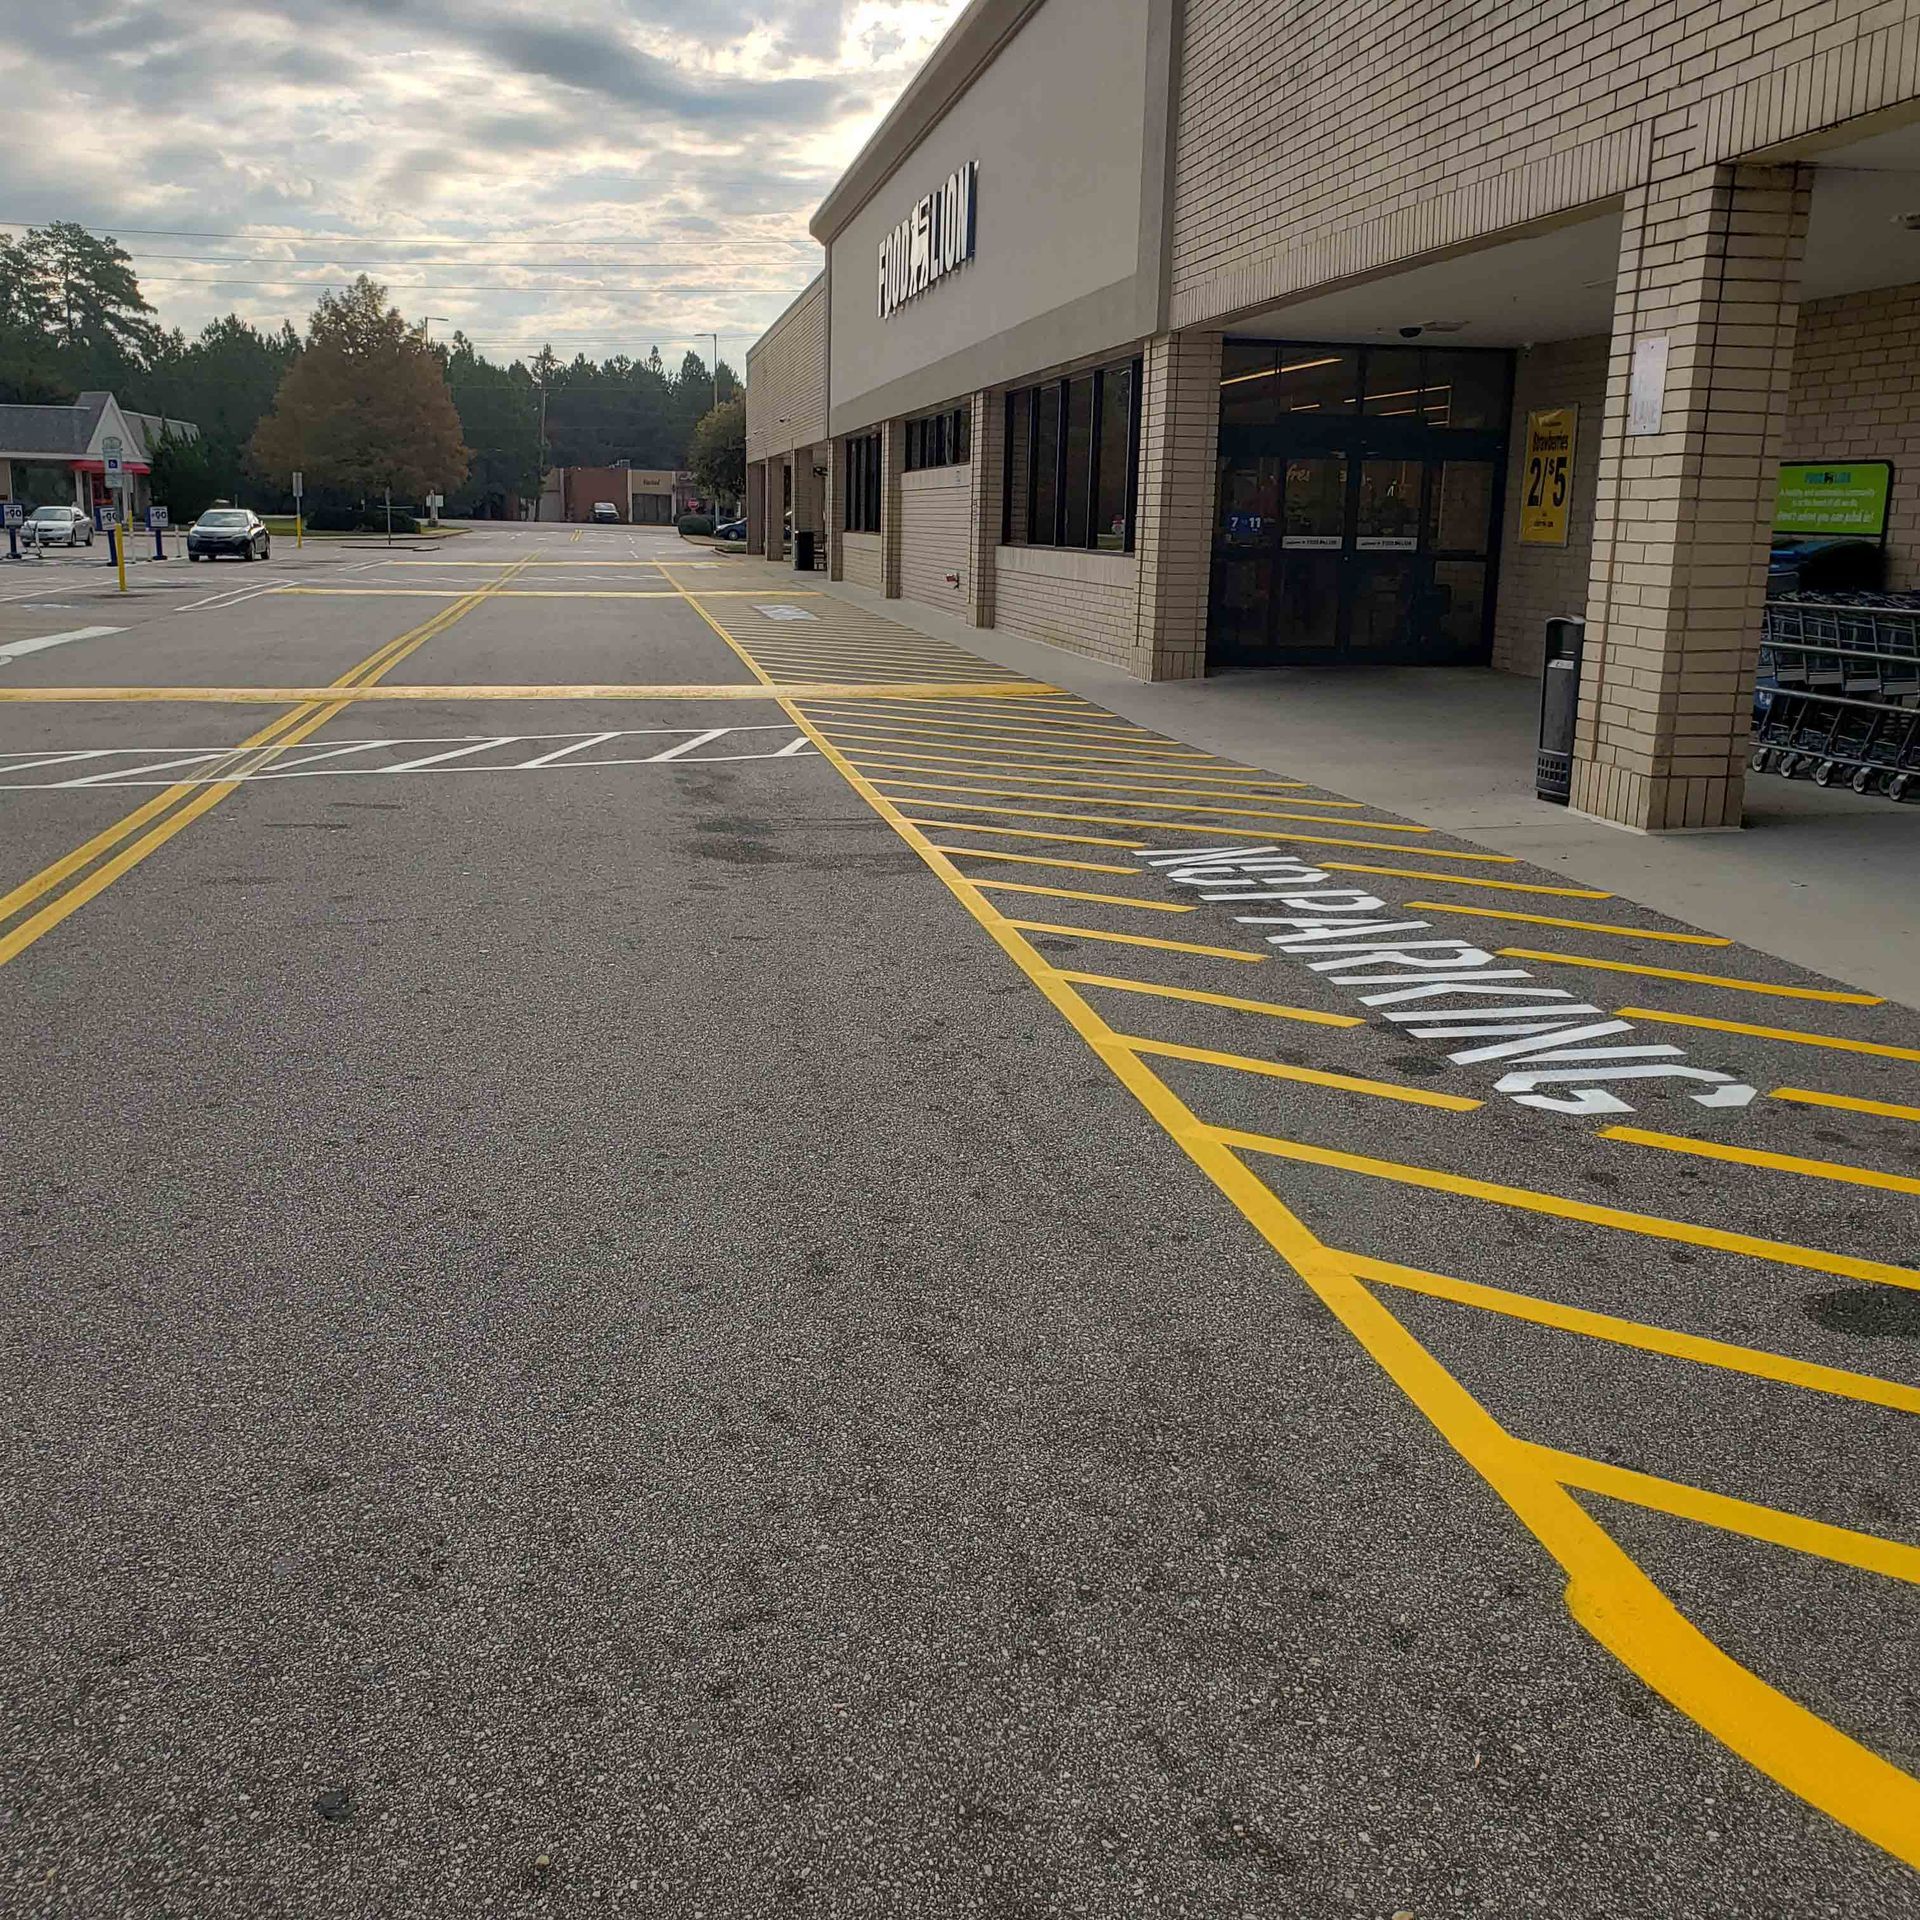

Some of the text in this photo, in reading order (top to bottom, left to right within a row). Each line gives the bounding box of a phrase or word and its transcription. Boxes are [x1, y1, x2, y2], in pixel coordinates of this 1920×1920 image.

[878, 160, 980, 319] FOOD LION
[1231, 517, 1239, 528] 7
[1249, 517, 1261, 528] 11
[1131, 846, 1758, 1115] NO PARKING
